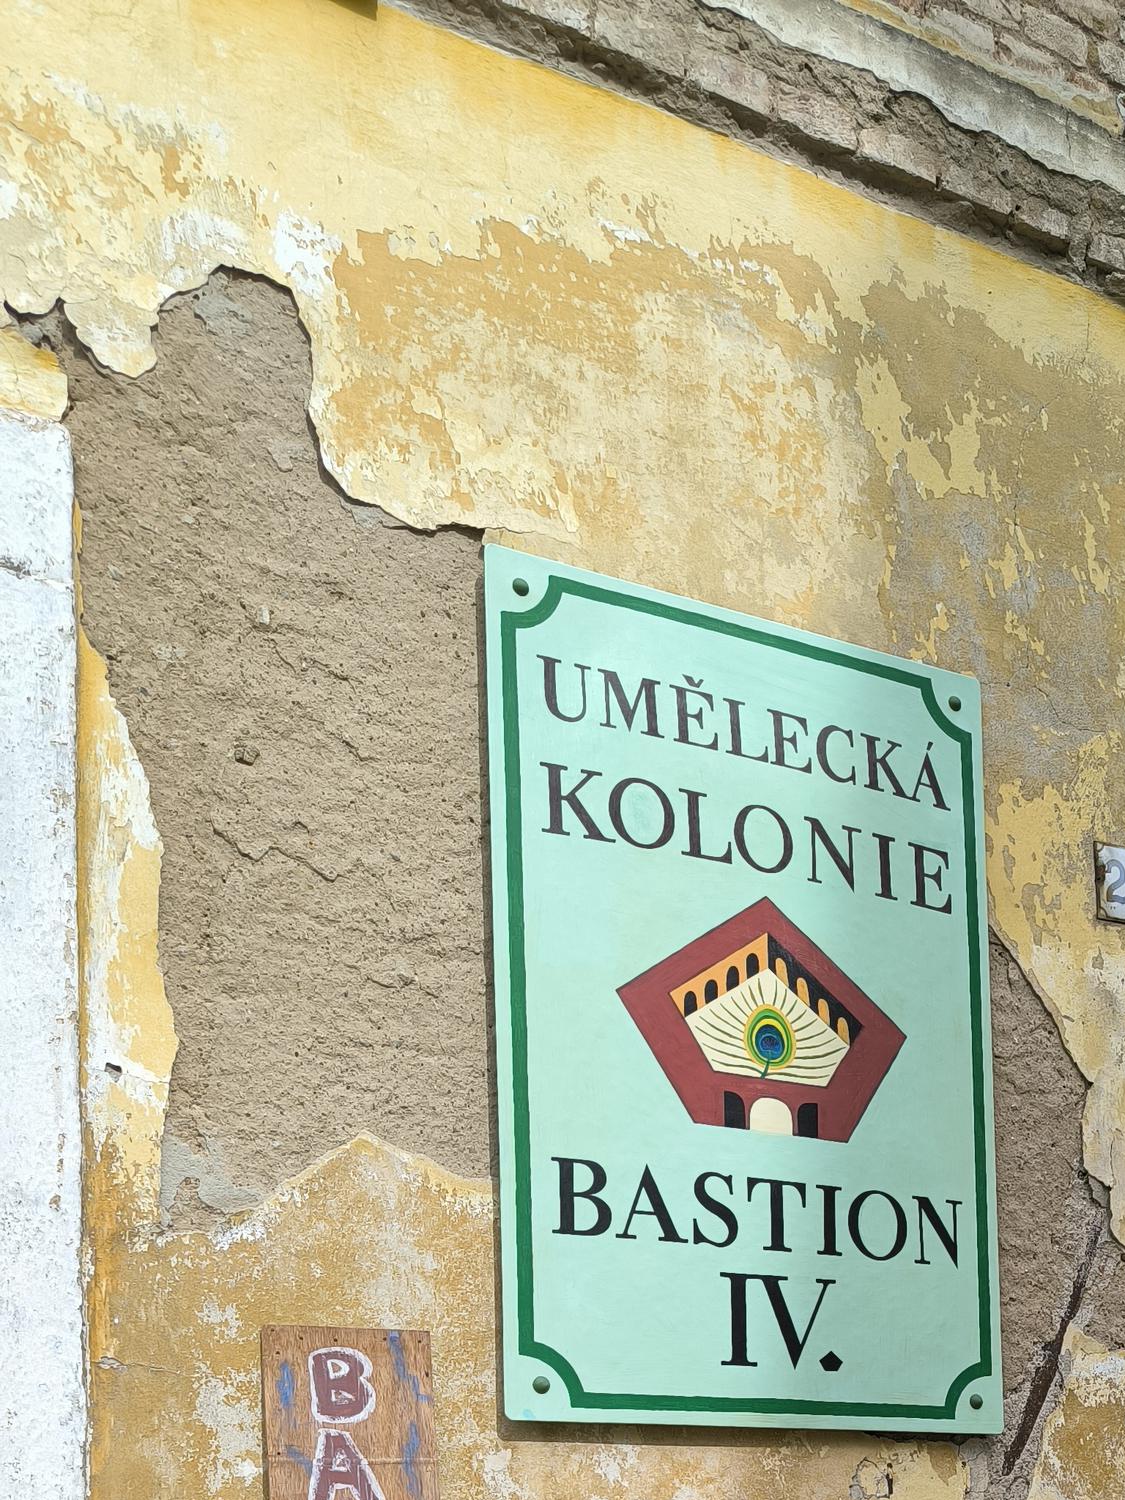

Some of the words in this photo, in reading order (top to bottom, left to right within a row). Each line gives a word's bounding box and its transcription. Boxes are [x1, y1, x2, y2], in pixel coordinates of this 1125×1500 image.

[536, 653, 952, 812] UMĚLECKÁ
[539, 761, 953, 915] KOLONIE
[550, 1156, 964, 1269] BASTION
[720, 1271, 844, 1373] IV.
